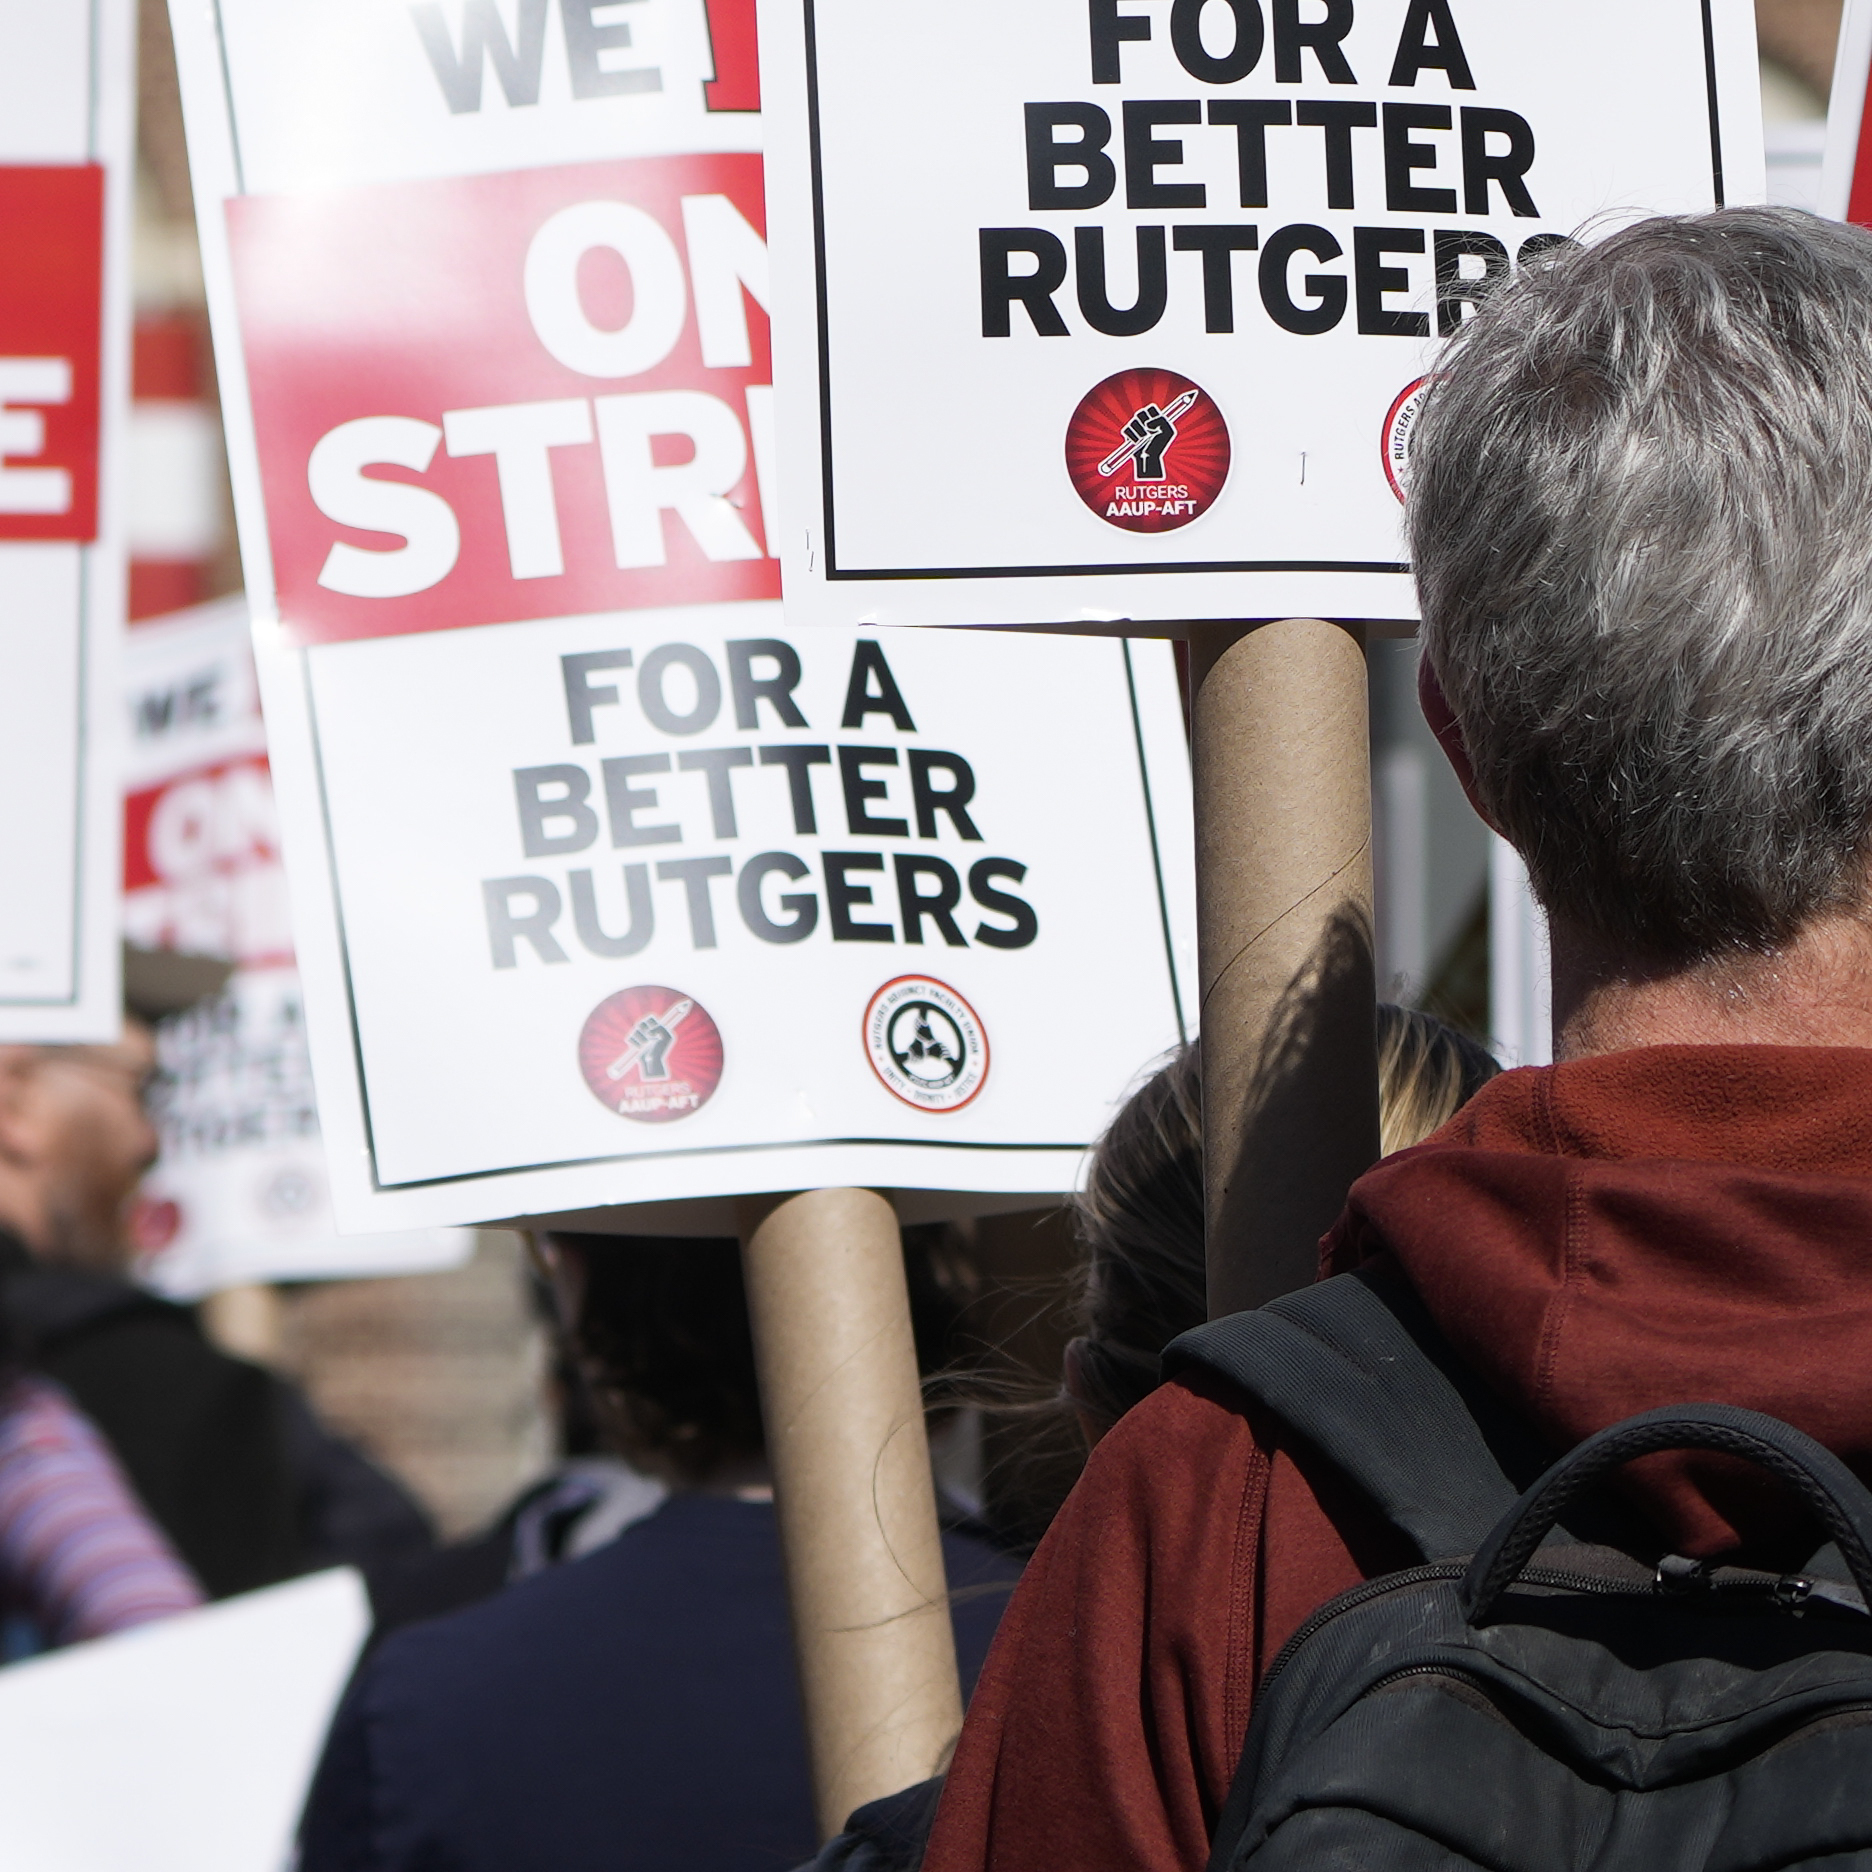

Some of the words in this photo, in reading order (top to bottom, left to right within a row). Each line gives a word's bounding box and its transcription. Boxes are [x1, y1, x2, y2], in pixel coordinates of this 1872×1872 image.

[1024, 98, 1540, 218] BETTER
[980, 225, 1586, 339] RUTGER
[307, 386, 778, 600] STR
[1106, 500, 1197, 516] AAUP-AFT
[1115, 485, 1188, 500] RUTGERS
[560, 637, 807, 746] FOR
[840, 639, 918, 735] A
[512, 744, 986, 859] BETTER
[480, 851, 1039, 971] RUTGERS
